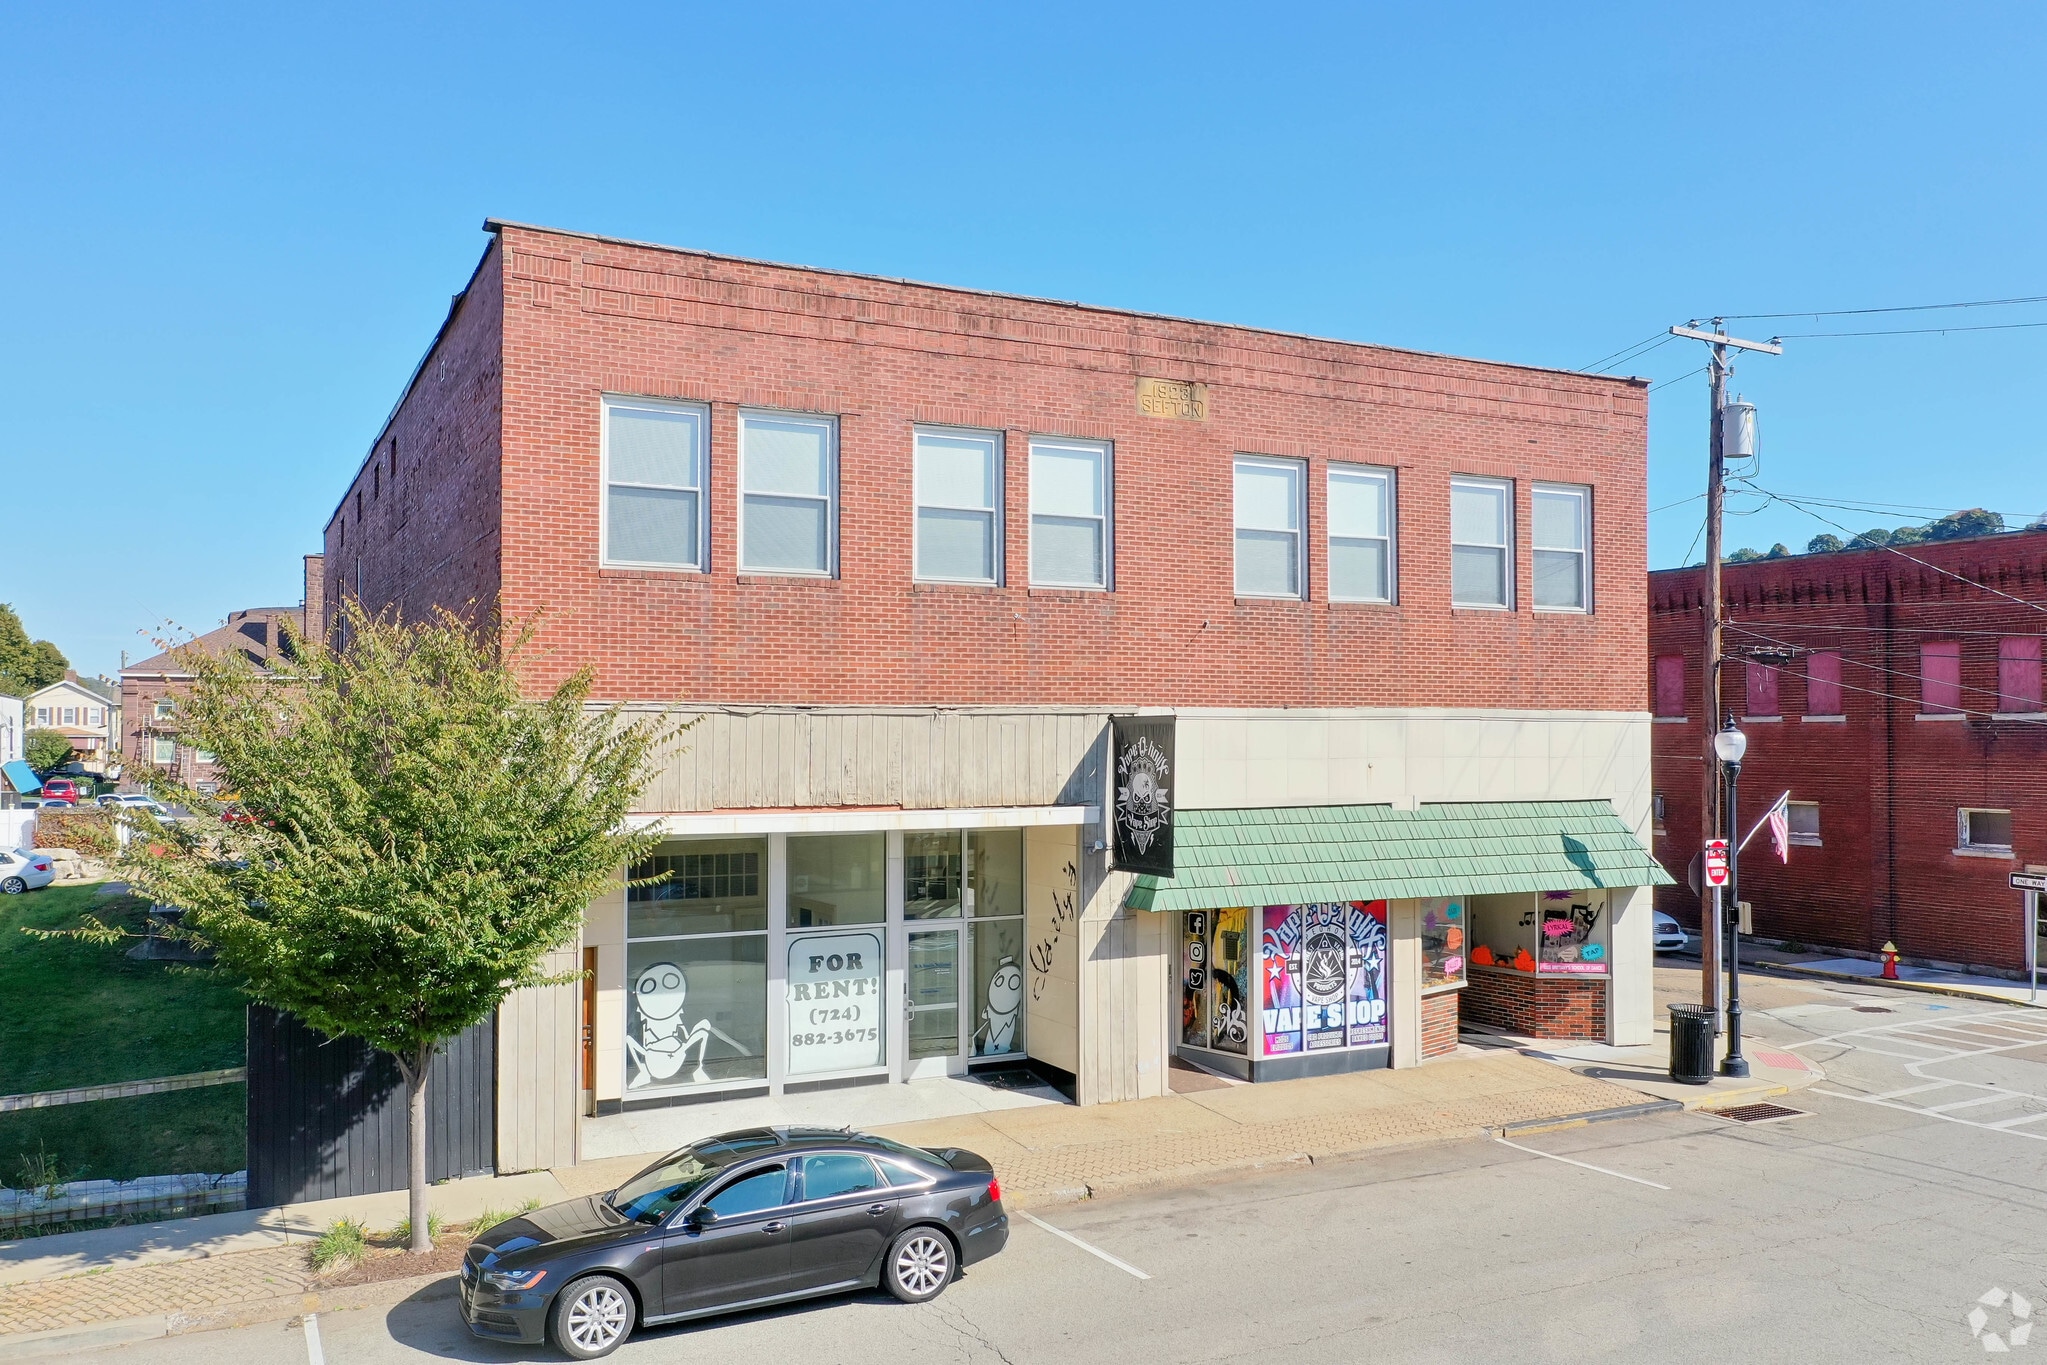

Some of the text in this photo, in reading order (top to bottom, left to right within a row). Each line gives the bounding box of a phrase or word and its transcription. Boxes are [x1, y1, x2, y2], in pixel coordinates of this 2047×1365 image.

[1153, 383, 1191, 401] 1923
[1141, 397, 1204, 418] SEFTON
[1547, 923, 1569, 932] LYRICAL
[1585, 947, 1600, 957] TAP
[808, 952, 863, 973] FOR
[793, 977, 877, 1002] RENT!
[809, 1004, 861, 1026] (724)
[792, 1027, 878, 1047] 882-3675
